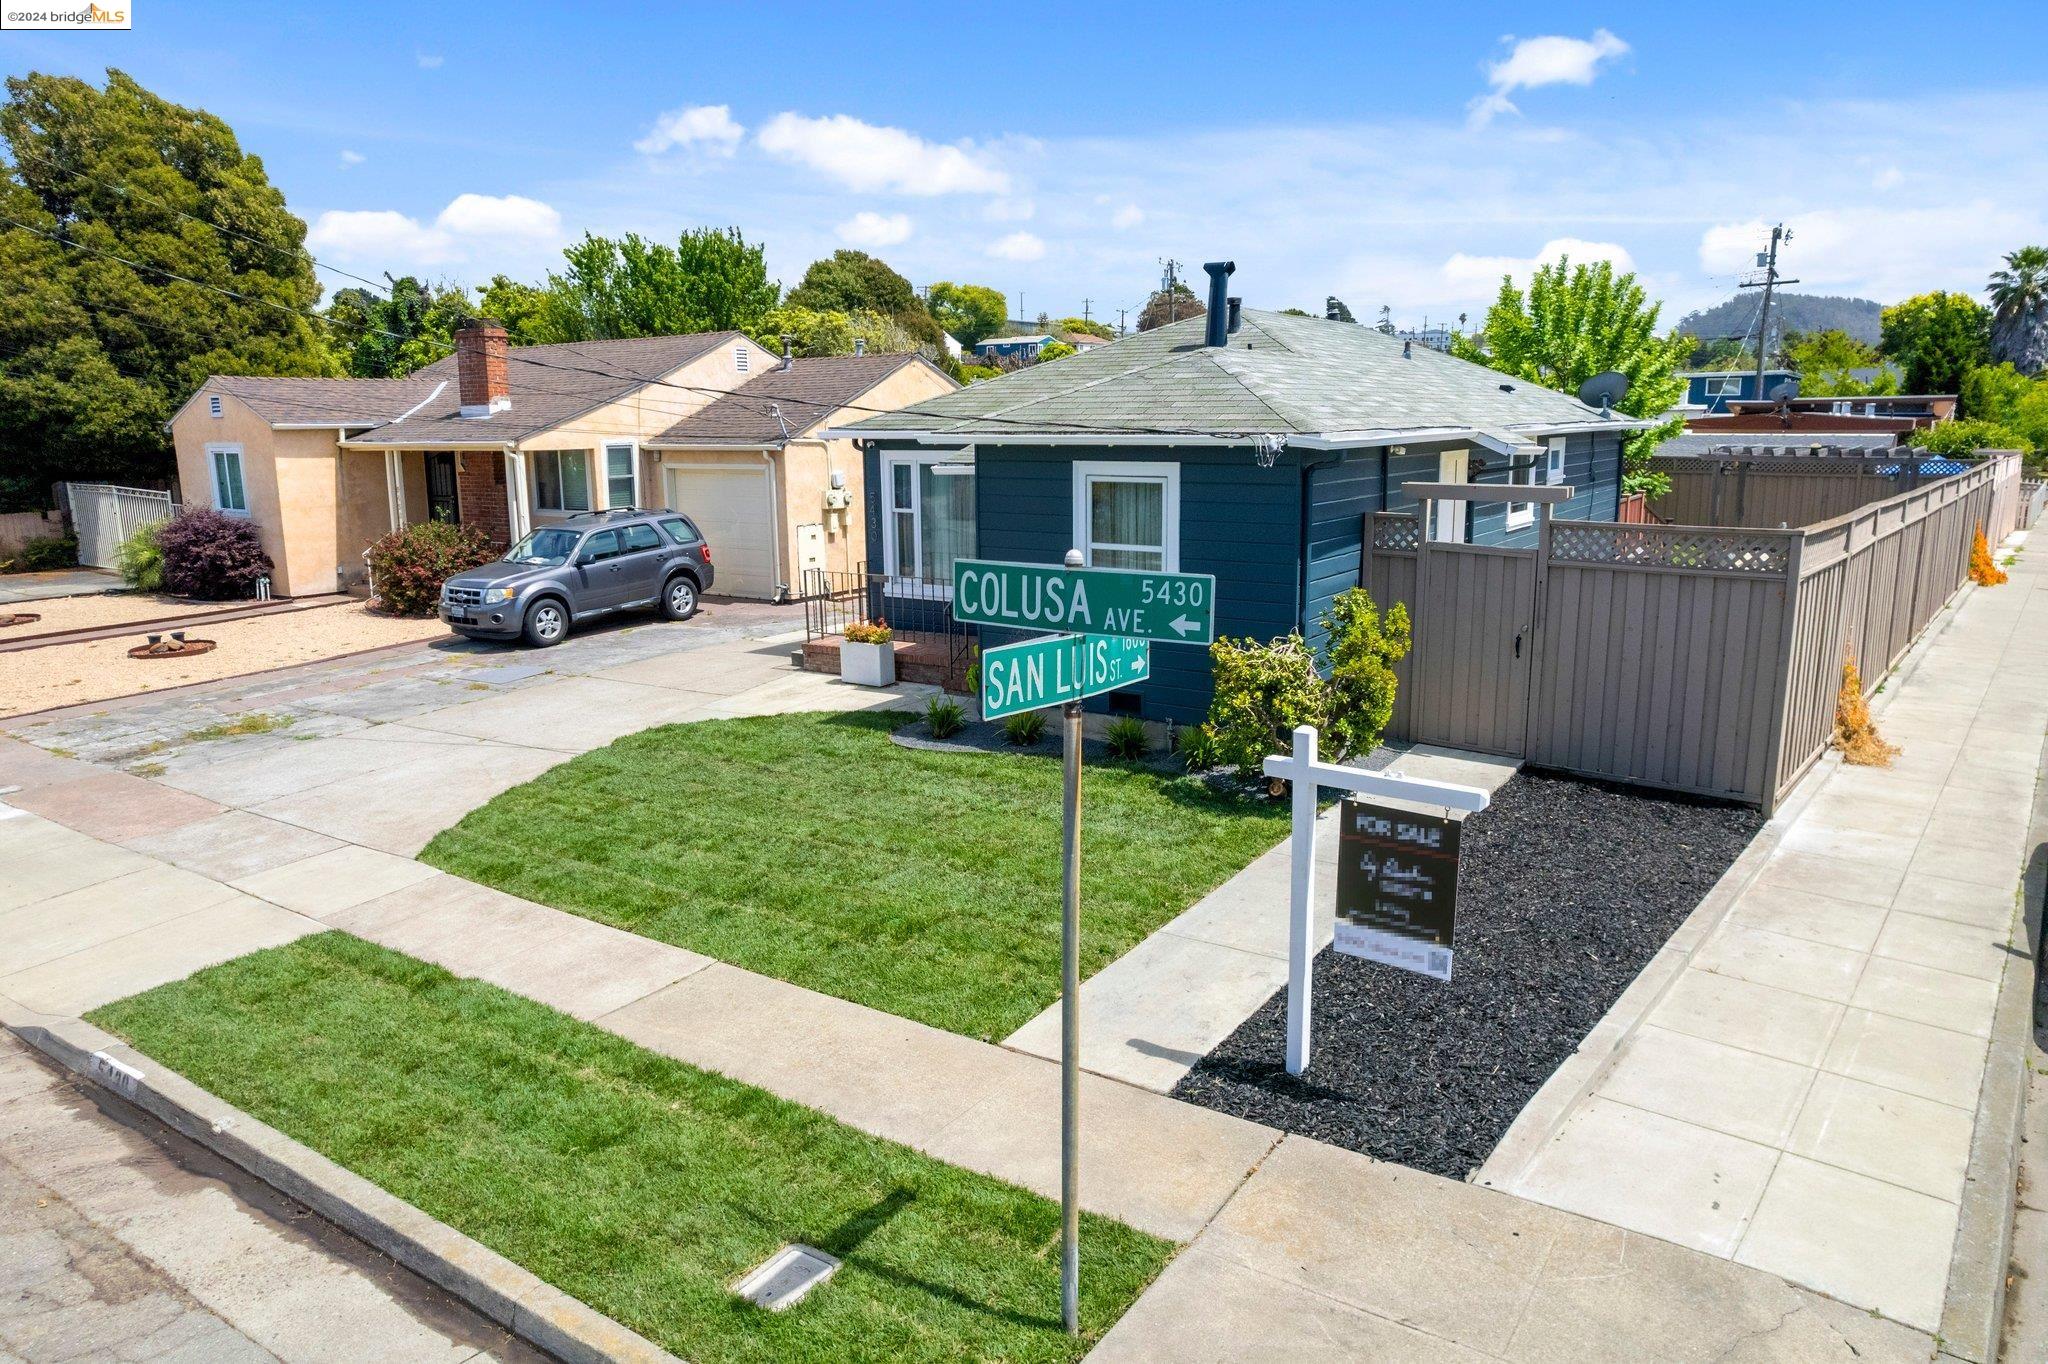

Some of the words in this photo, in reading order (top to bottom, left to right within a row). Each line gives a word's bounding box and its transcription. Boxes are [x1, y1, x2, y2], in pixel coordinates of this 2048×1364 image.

[869, 491, 878, 542] 5430
[959, 569, 1092, 625] COLUSA
[1103, 607, 1152, 635] AVE.
[1141, 579, 1204, 607] 5430
[987, 652, 1044, 710] SAN
[1056, 639, 1107, 694] LUIS
[1109, 657, 1123, 682] ST.
